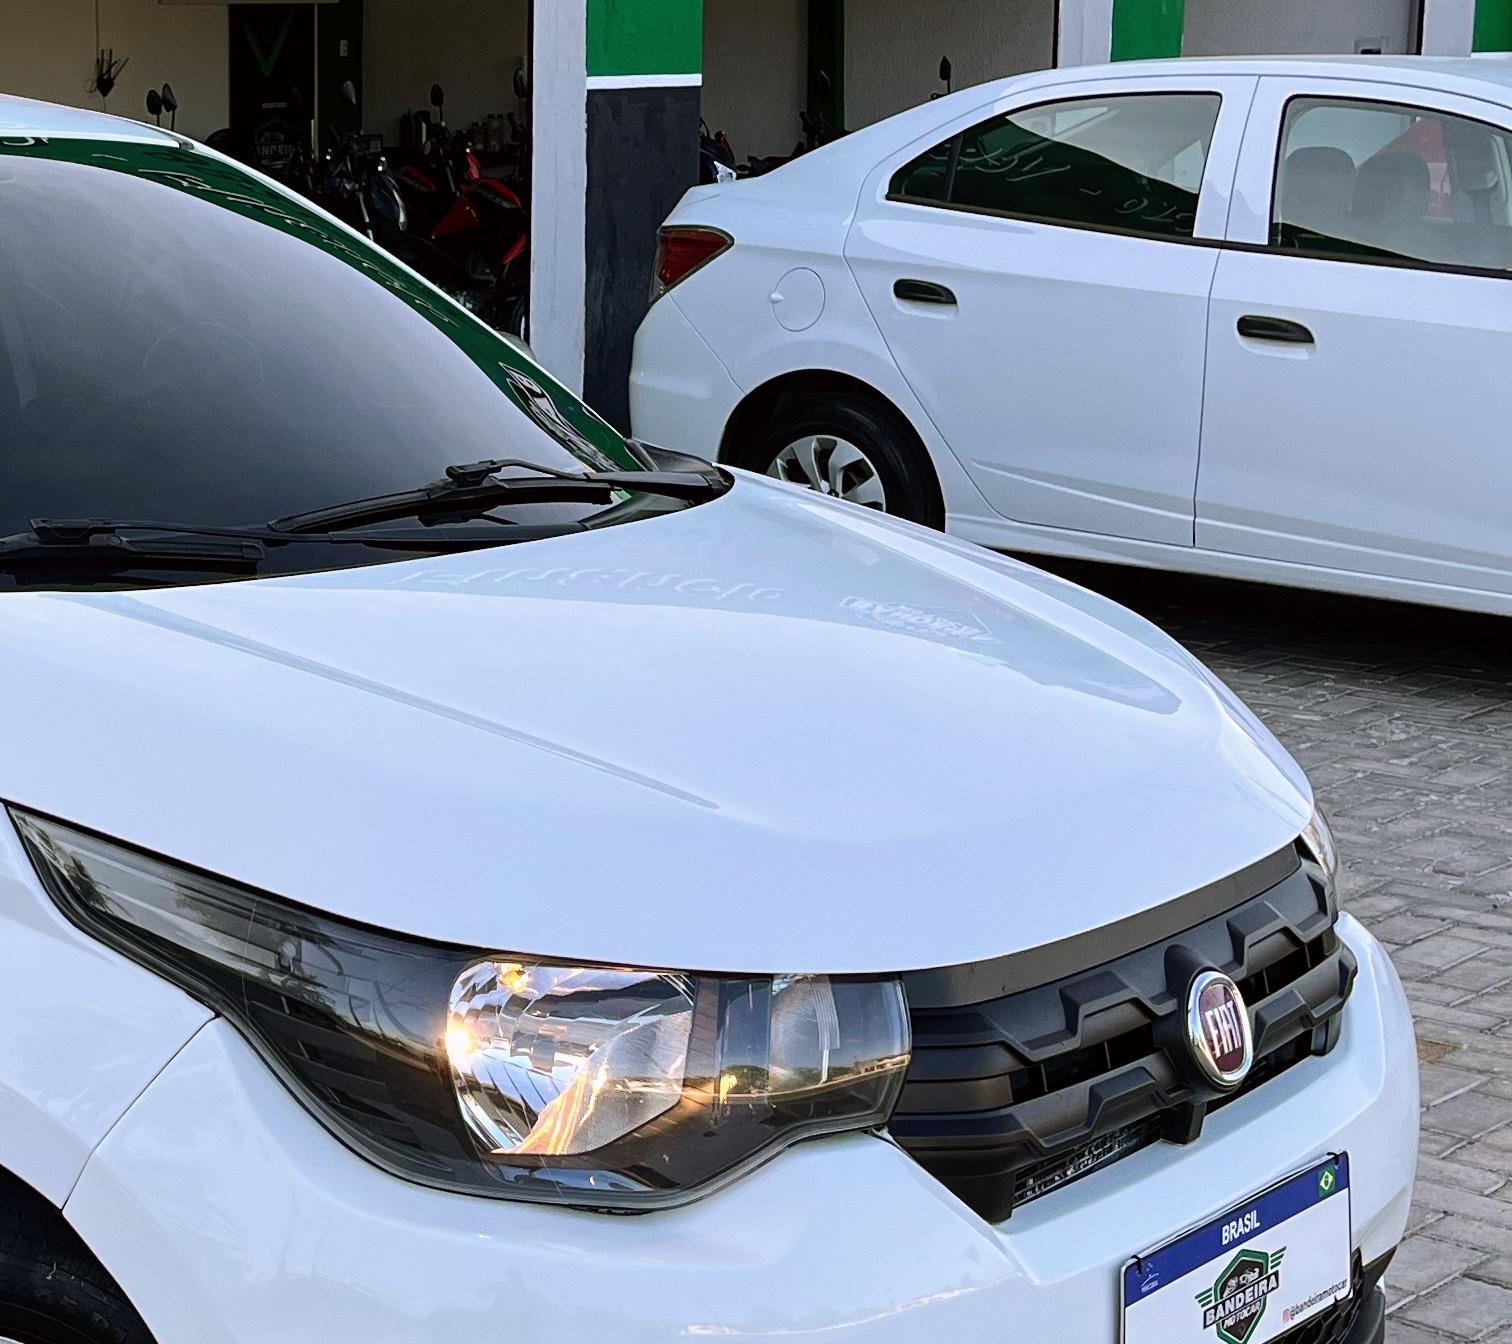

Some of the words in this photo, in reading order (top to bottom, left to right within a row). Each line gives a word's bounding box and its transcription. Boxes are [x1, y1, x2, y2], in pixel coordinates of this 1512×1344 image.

[1205, 1000, 1243, 1059] FIAT
[1221, 1209, 1261, 1246] BRASIL
[1205, 1274, 1278, 1327] BANDEIRA
[1223, 1301, 1261, 1329] MOTOCAR
